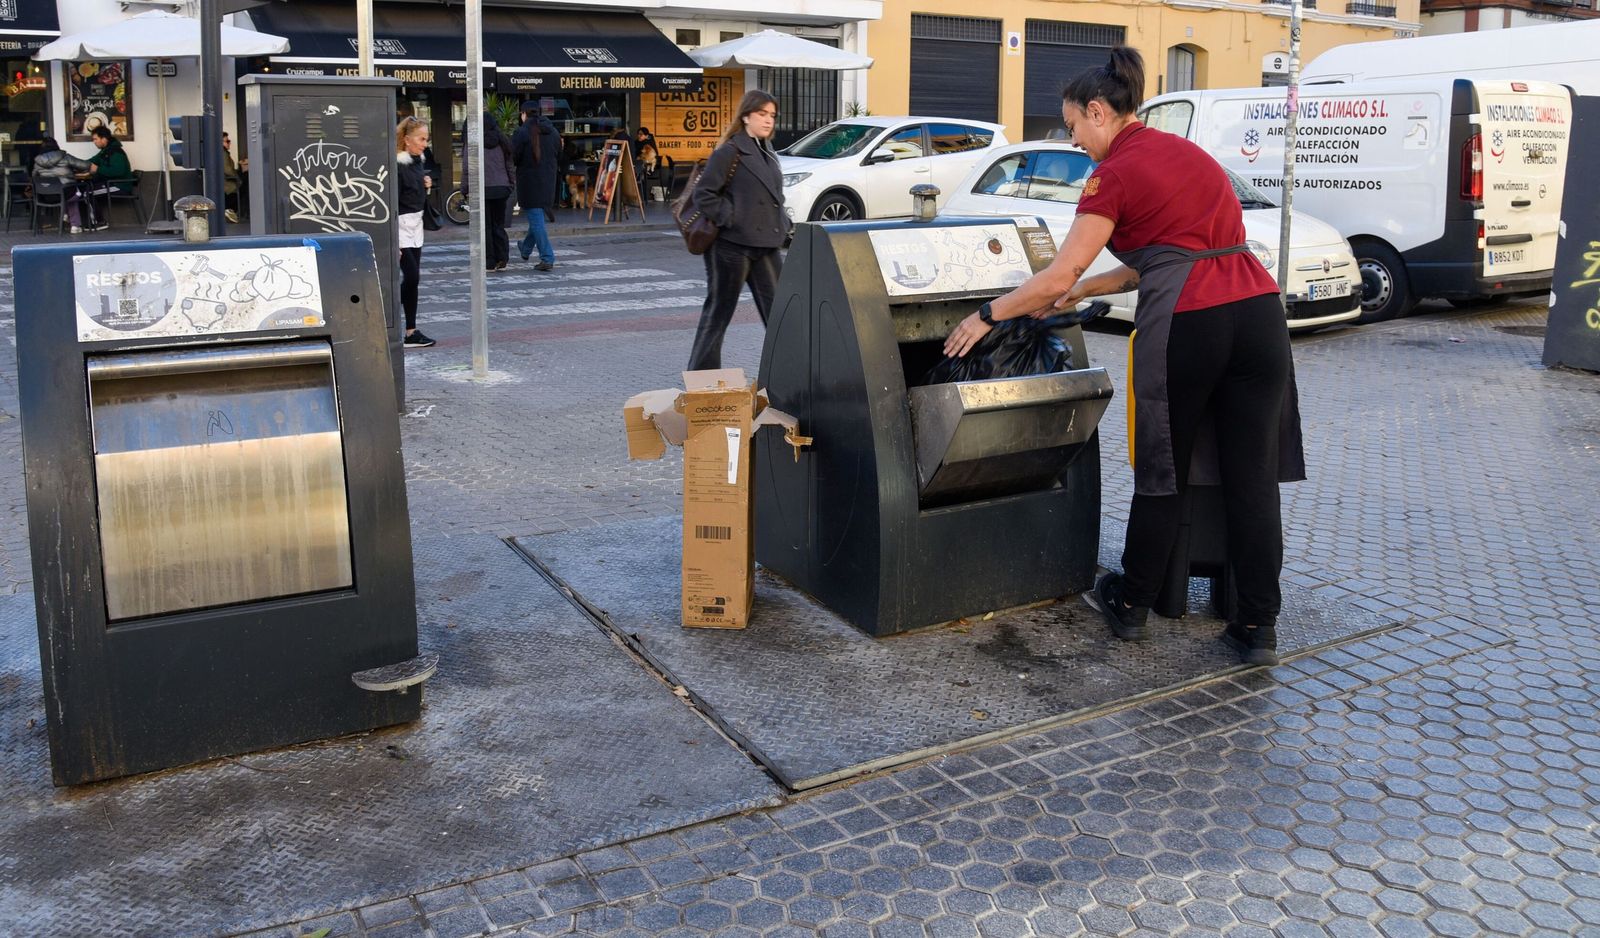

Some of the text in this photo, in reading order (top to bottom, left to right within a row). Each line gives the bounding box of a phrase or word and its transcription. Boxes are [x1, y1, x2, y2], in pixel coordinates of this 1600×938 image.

[286, 66, 325, 76] Cruzcampo
[394, 69, 435, 83] OBRADOR
[448, 70, 467, 79] Cruzc
[510, 77, 543, 85] Cruzcampo
[560, 75, 602, 89] CAFETERÍA
[610, 77, 646, 89] OBRADOR
[662, 77, 692, 85] Cruzcampo
[1243, 99, 1389, 121] INSTALACNES CLIMACO S.L.
[1487, 104, 1535, 122] INSTALACIONES
[700, 111, 717, 128] GO
[1506, 129, 1566, 140] AIRE ACONDICIONADO
[658, 140, 681, 149] BAKERY
[687, 141, 702, 149] FOOD
[1295, 137, 1360, 150] ALEFACCIÓN
[1295, 151, 1359, 164] ENTILACIÓN
[1303, 178, 1382, 190] AUTORIZADOS
[1492, 180, 1530, 192] www.climaco.es
[1494, 249, 1524, 263] 8852 KDT
[86, 271, 162, 289] RESTOS
[1314, 281, 1348, 298] 5580 HNF
[275, 318, 303, 326] LIPASAM
[695, 405, 737, 414] cecotec
